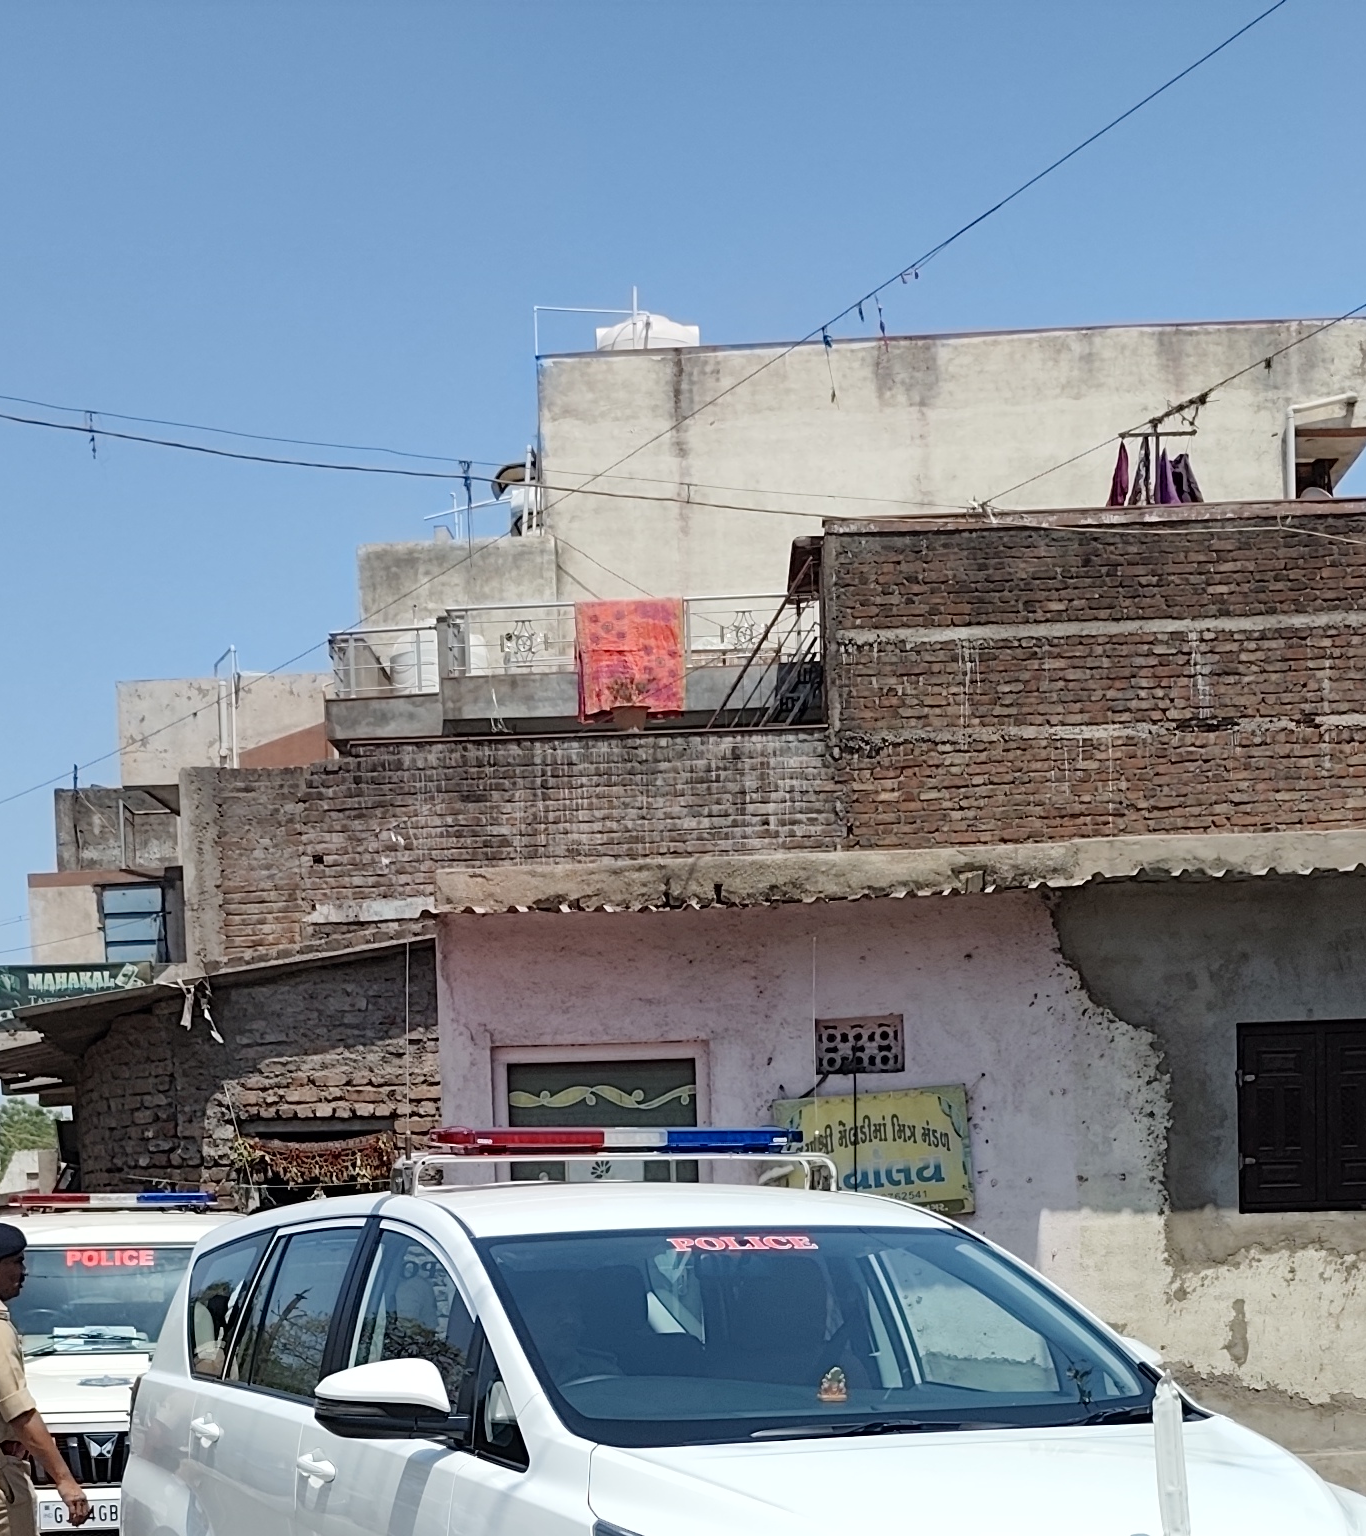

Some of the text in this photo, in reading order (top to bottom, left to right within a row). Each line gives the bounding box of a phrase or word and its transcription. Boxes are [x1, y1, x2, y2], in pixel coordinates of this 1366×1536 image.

[27, 970, 115, 994] MAHAKAL
[666, 1235, 819, 1252] POLICE
[65, 1249, 155, 1267] POLICE
[54, 1504, 118, 1524] G4GB
